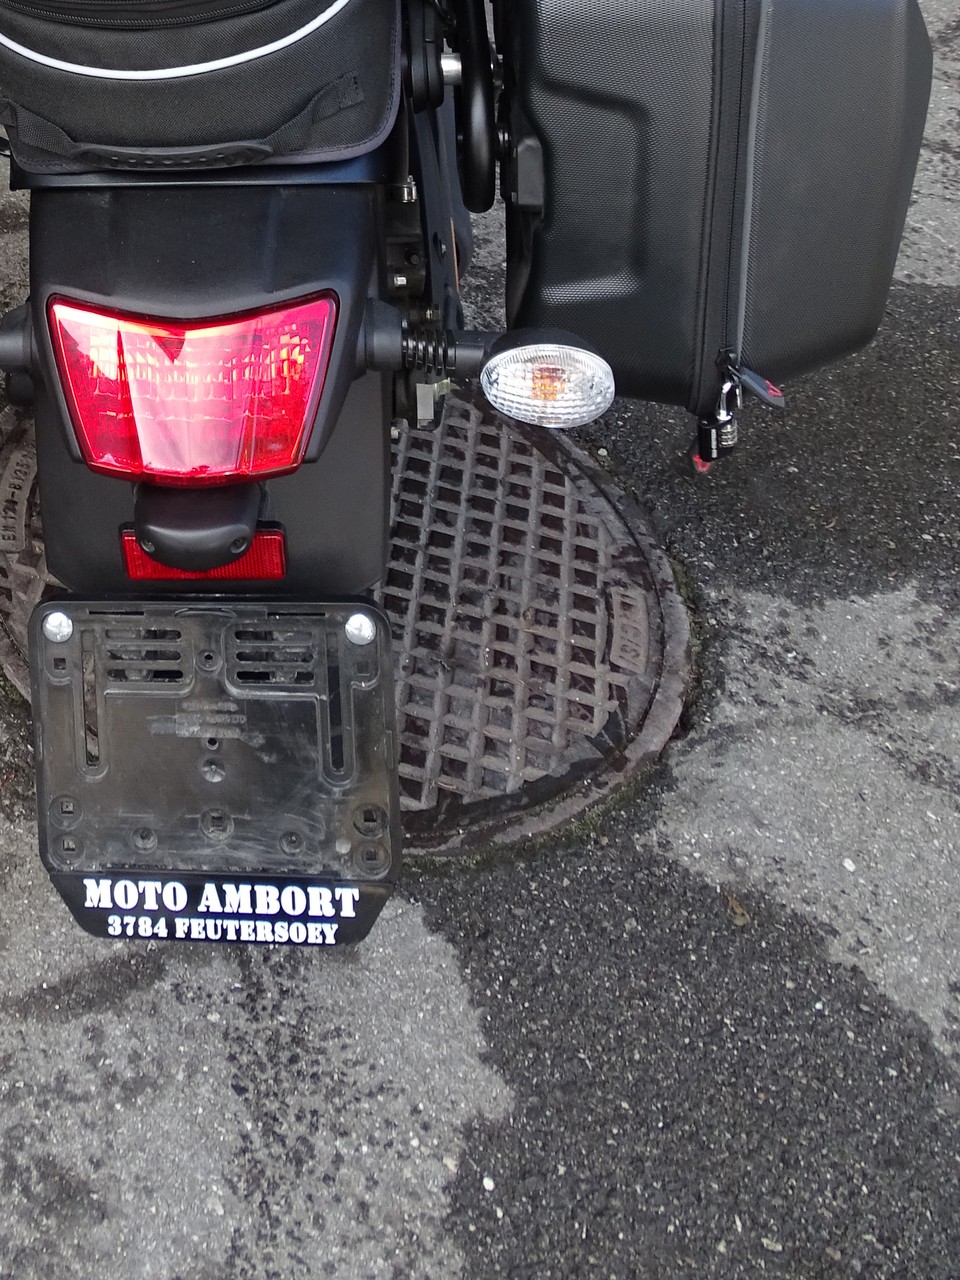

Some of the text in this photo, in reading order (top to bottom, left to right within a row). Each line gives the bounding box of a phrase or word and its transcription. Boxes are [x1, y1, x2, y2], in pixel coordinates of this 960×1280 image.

[83, 878, 360, 918] MOTO AMBORT
[107, 915, 338, 945] 3784 FEUTERSOEY
